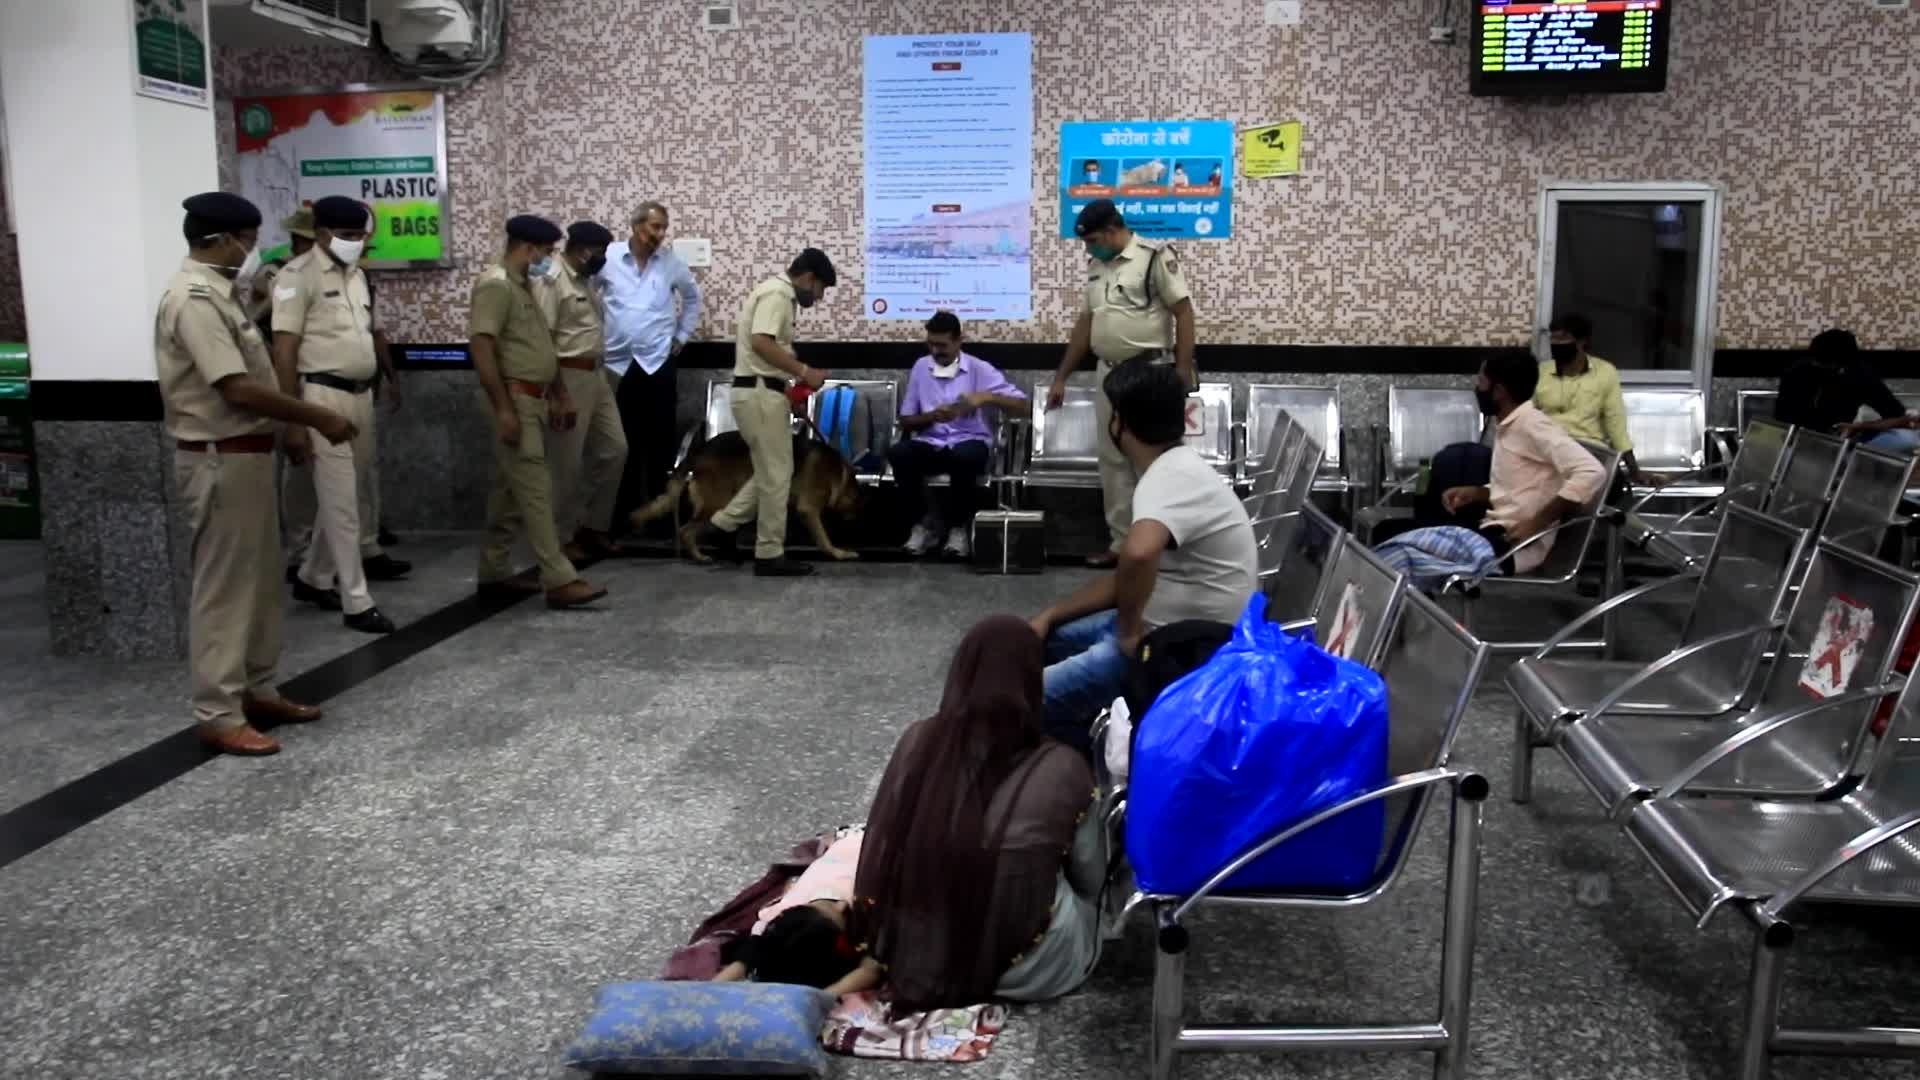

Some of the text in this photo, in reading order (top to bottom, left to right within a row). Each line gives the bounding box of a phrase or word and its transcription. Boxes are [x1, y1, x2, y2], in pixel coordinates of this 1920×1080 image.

[1101, 127, 1148, 146] कोरोना
[1152, 127, 1166, 145] से
[361, 177, 437, 199] PLASTIC
[391, 215, 439, 236] BAGS
